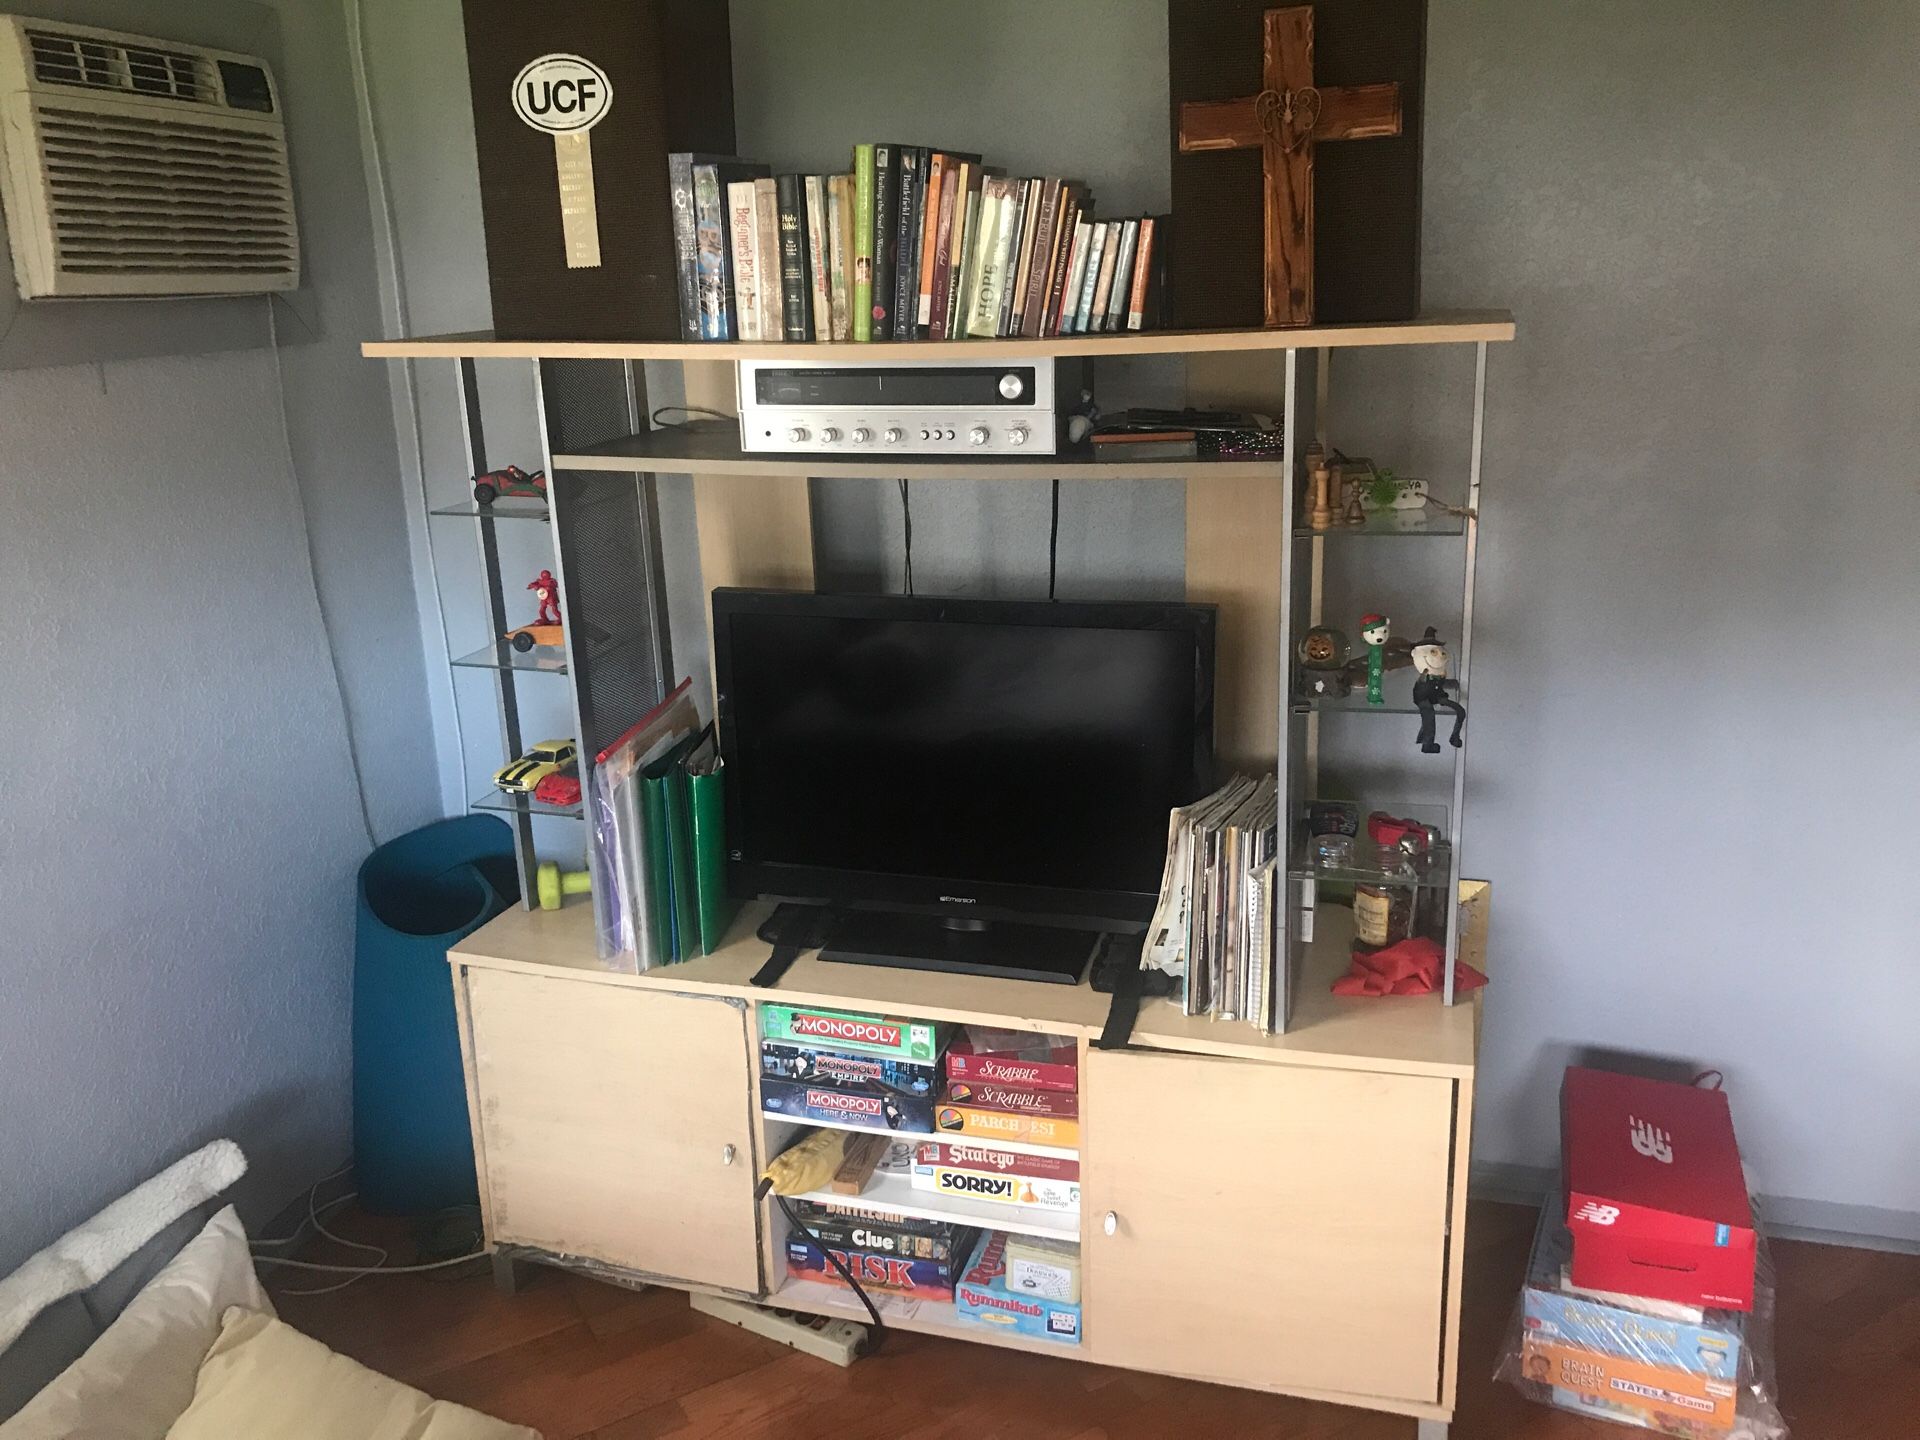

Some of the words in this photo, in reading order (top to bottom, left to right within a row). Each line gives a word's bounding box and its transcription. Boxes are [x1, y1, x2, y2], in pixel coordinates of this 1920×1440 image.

[526, 78, 596, 115] UCF
[876, 171, 885, 200] Healing
[902, 174, 912, 216] Battlefield
[877, 200, 885, 212] the
[781, 214, 798, 223] Holy
[782, 223, 798, 231] Bible
[877, 213, 885, 229] Soul
[1038, 217, 1051, 248] FRUIT
[876, 238, 884, 265] Woman
[978, 264, 998, 318] HOPE
[801, 1017, 898, 1043] MONOPOLY
[817, 1060, 879, 1076] MONOPOLY
[951, 1056, 966, 1068] MB
[980, 1060, 1039, 1082] SCRABBLE
[831, 1072, 866, 1083] EMPIRE
[809, 1094, 879, 1113] MONOPOLY
[978, 1087, 1046, 1109] SCRABBLE
[819, 1108, 839, 1118] HERE
[840, 1110, 848, 1120] &
[849, 1112, 869, 1121] NOW
[969, 1113, 1056, 1136] PARCHESI
[949, 1144, 1015, 1169] Stratego
[941, 1173, 1012, 1197] SORRY!
[851, 1229, 895, 1250] Clue
[823, 1248, 916, 1289] RISK
[960, 1287, 1044, 1317] Rummikub
[1560, 1357, 1605, 1377] BRAIN
[1559, 1369, 1605, 1391] QUEST
[1611, 1378, 1659, 1398] STATES
[1677, 1395, 1715, 1412] Game
